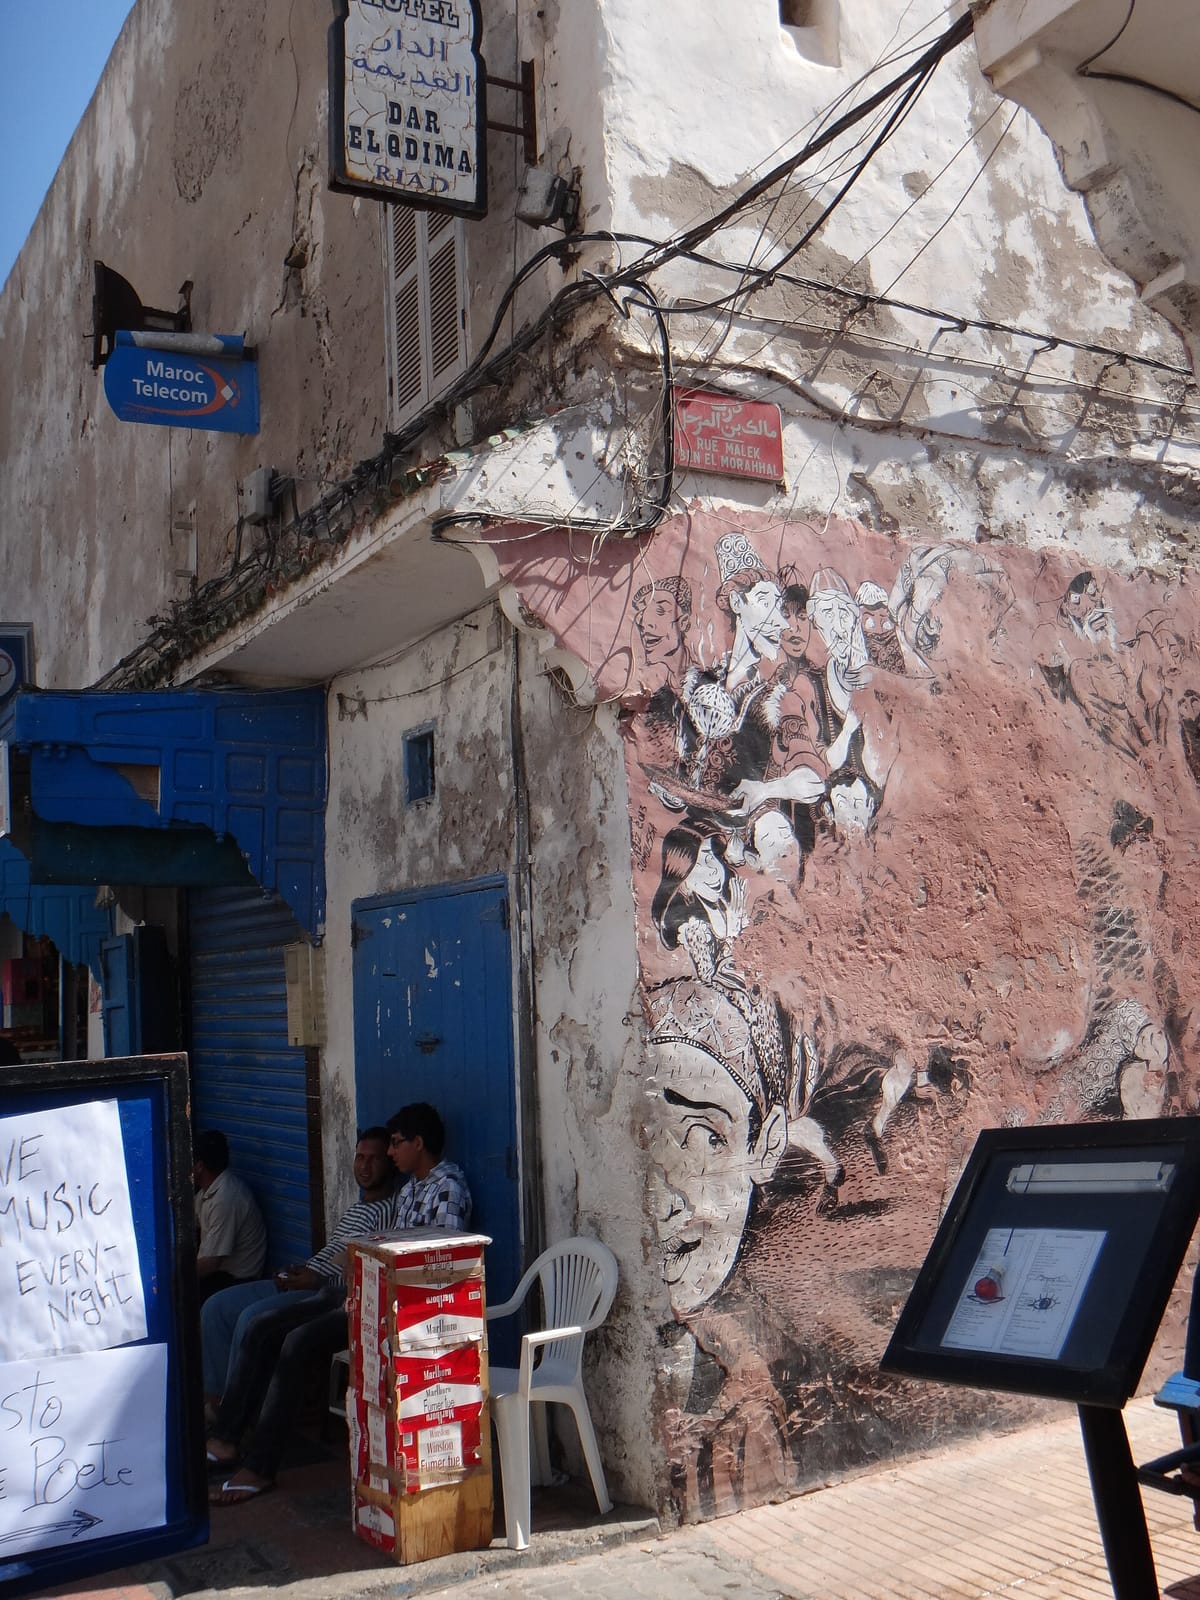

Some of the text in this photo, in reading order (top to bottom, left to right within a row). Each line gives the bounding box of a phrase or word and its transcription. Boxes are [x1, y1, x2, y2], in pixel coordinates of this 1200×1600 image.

[361, 0, 459, 28] OTEL
[371, 29, 446, 61] الدار
[388, 101, 440, 135] DAR
[376, 164, 449, 194] RIAD
[146, 360, 204, 384] Maroc
[132, 378, 208, 404] Telecom
[696, 437, 761, 460] RUE MALEK
[704, 452, 718, 467] EL
[425, 1292, 455, 1309] Marlboro
[426, 1319, 458, 1335] Marlboro
[423, 1364, 452, 1381] Marlboro
[425, 1384, 452, 1398] Marlboro
[423, 1398, 444, 1414] Fumer
[427, 1440, 454, 1454] Winston
[420, 1458, 446, 1473] Fumer
[447, 1455, 461, 1469] tue
